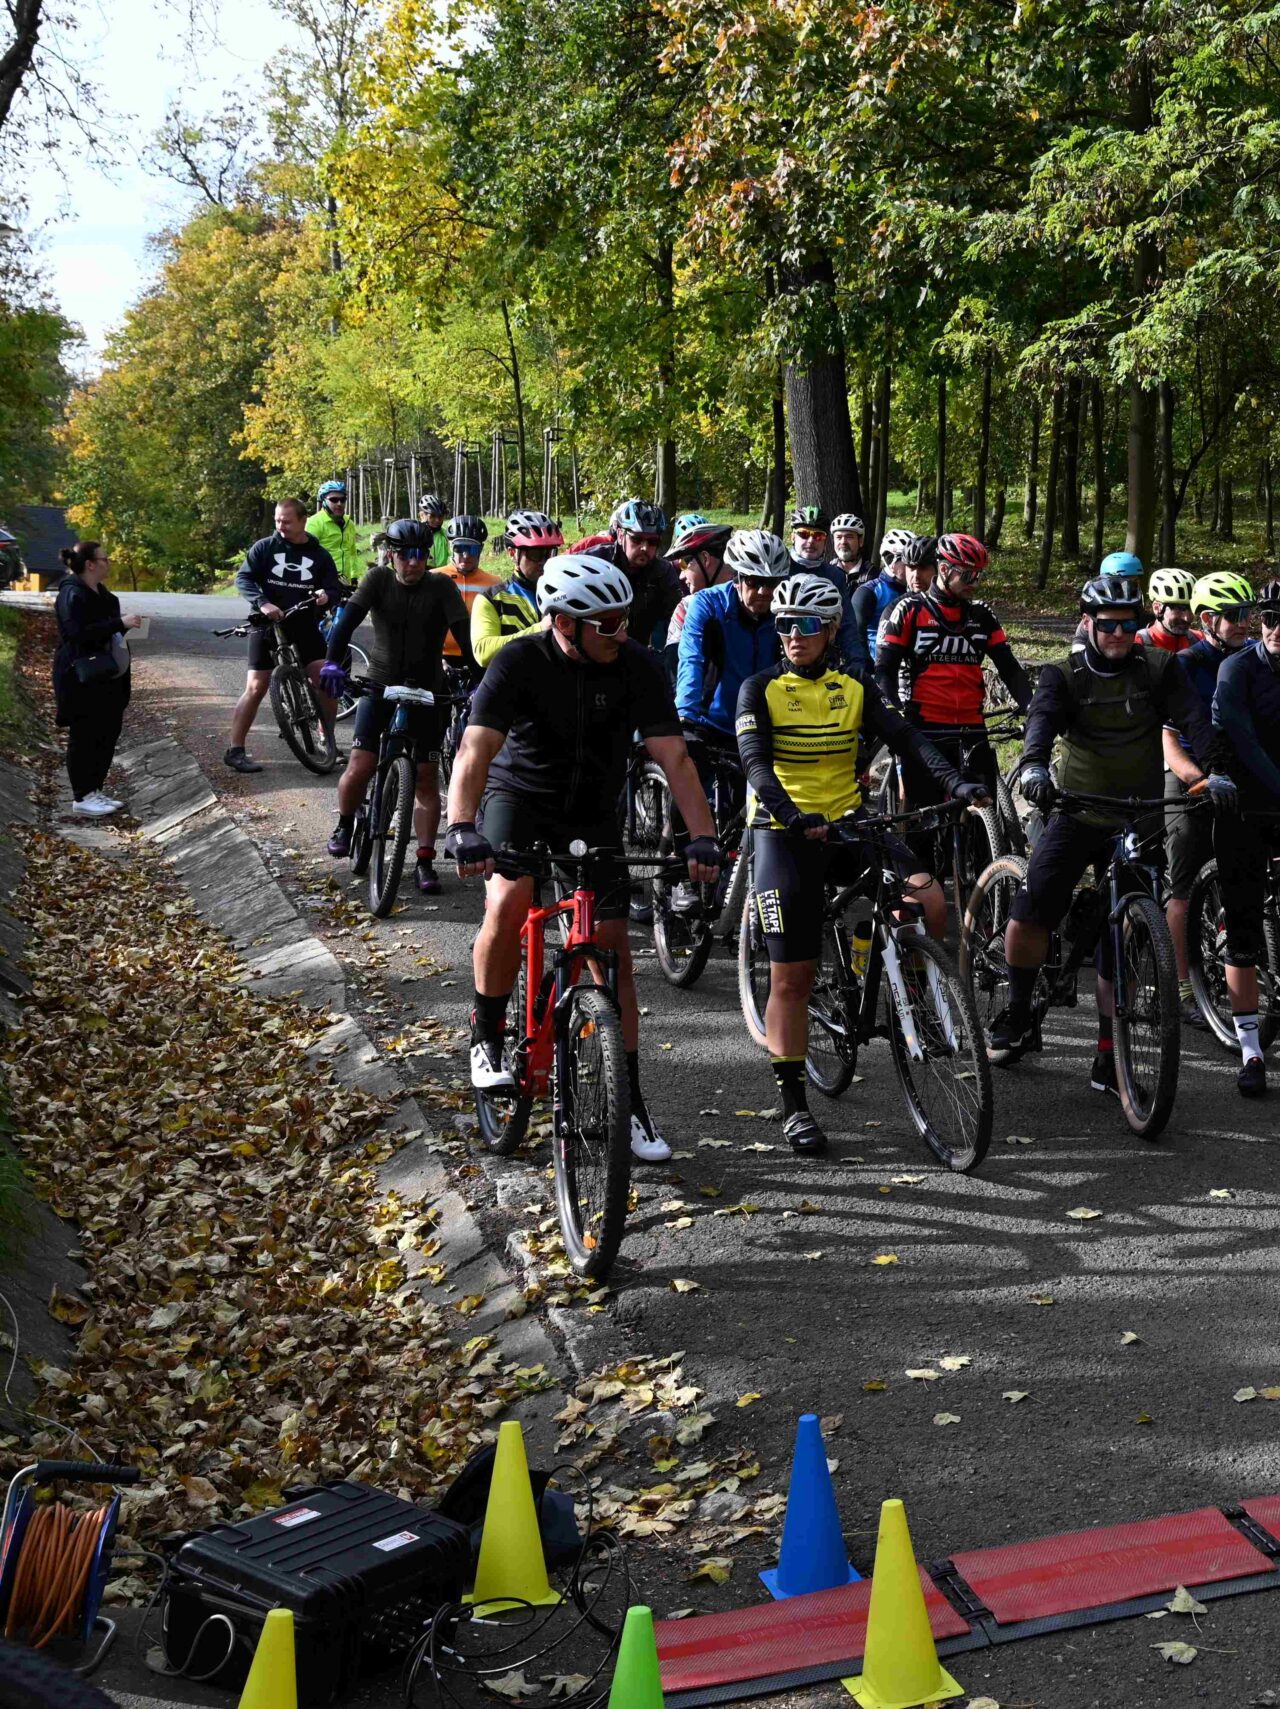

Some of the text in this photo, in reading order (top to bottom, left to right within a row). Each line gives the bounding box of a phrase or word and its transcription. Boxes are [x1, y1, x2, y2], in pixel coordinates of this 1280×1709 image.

[266, 578, 315, 590] UNDER ARMOUR
[758, 891, 771, 934] SLOVENIA
